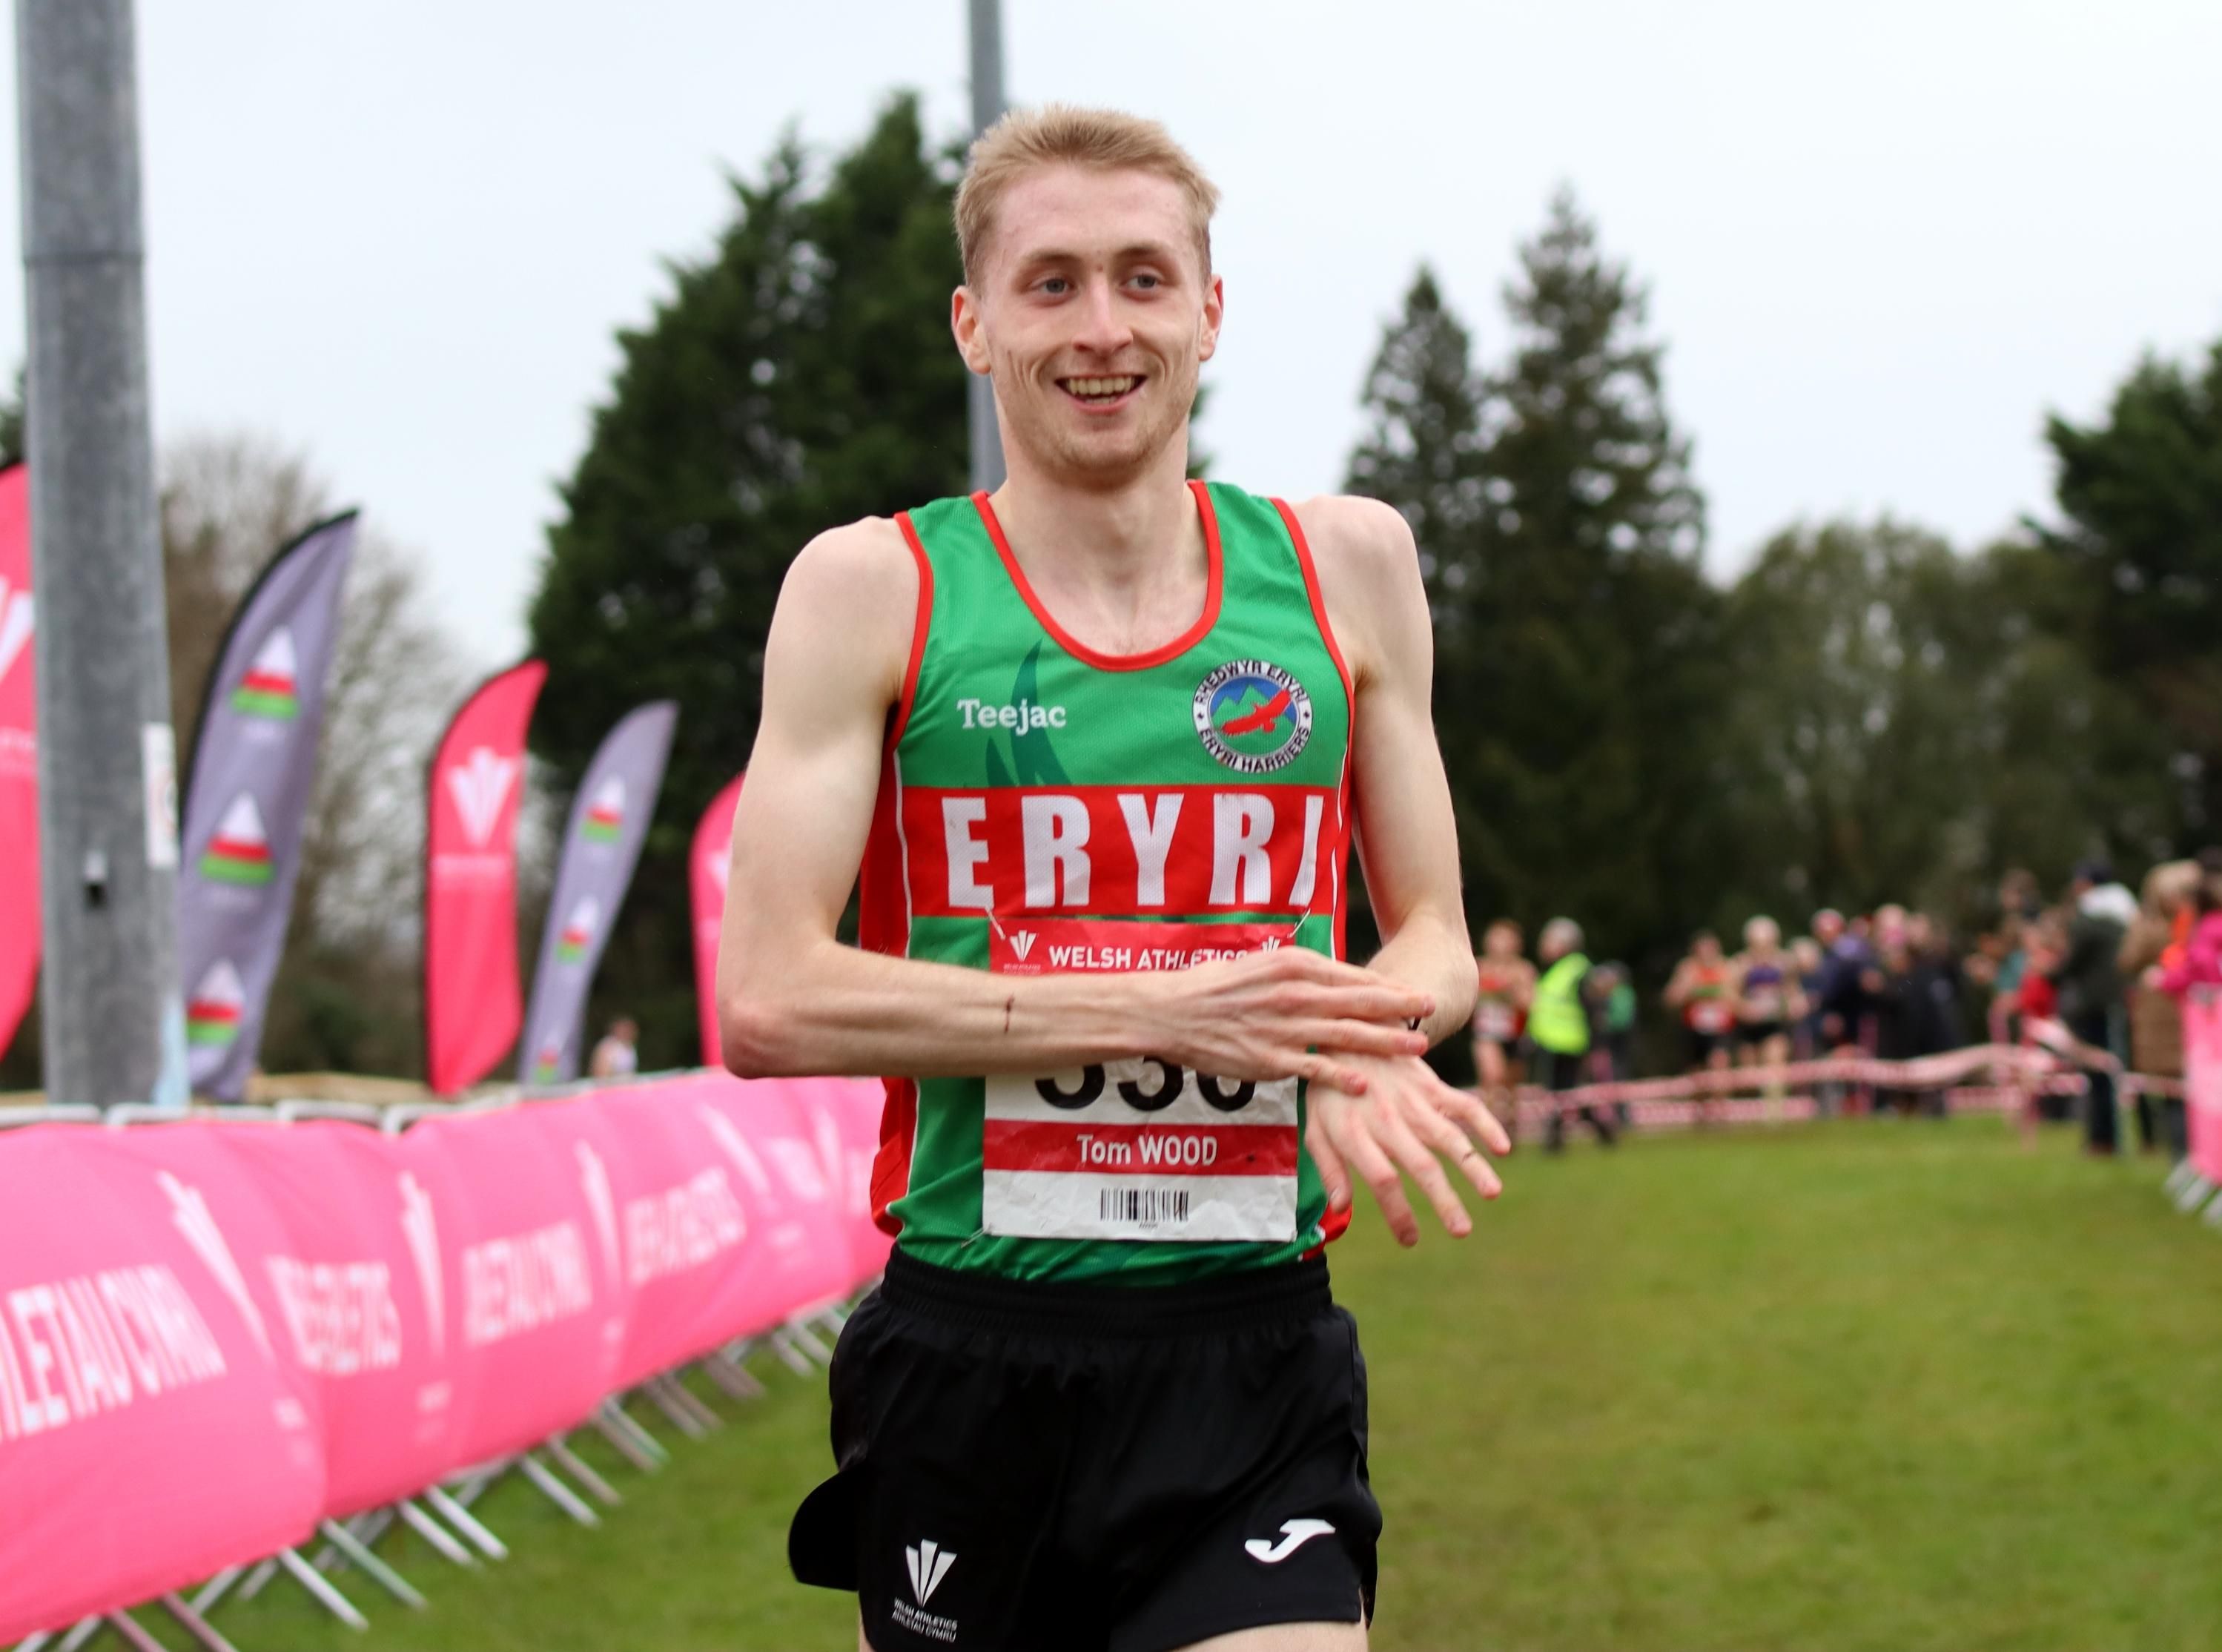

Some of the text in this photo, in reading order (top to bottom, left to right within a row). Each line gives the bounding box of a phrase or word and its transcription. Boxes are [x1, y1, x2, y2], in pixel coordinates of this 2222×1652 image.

[956, 698, 1066, 736] Teejac
[1200, 726, 1309, 773] ERYRI HARRIERS
[941, 793, 1324, 908] ERYRI
[1048, 945, 1131, 969] WELSH
[1077, 1134, 1218, 1166] Tom WOOD
